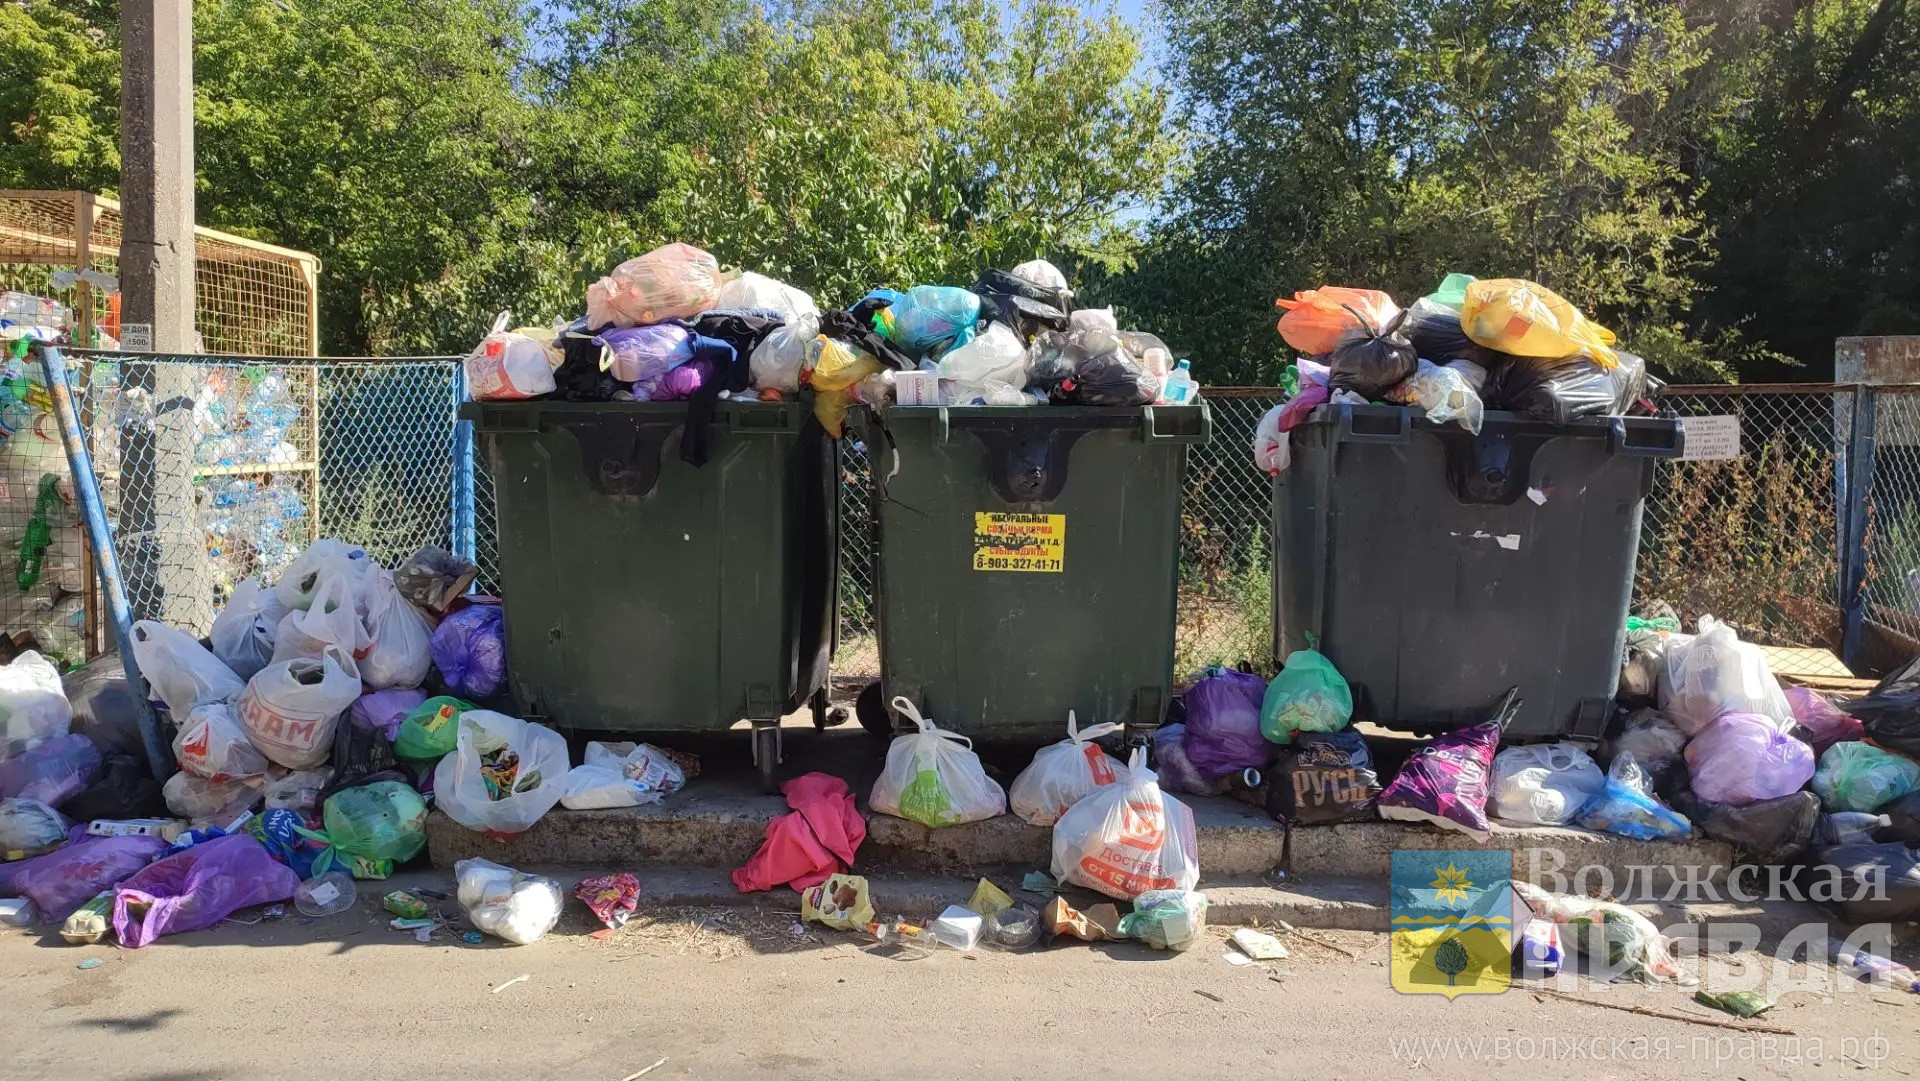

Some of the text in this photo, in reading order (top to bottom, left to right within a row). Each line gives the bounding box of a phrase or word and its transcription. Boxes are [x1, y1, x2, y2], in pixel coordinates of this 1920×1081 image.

[976, 557, 1060, 570] 8-903-327-41-71
[1291, 768, 1368, 808] РУСЬ
[1109, 871, 1125, 886] 15
